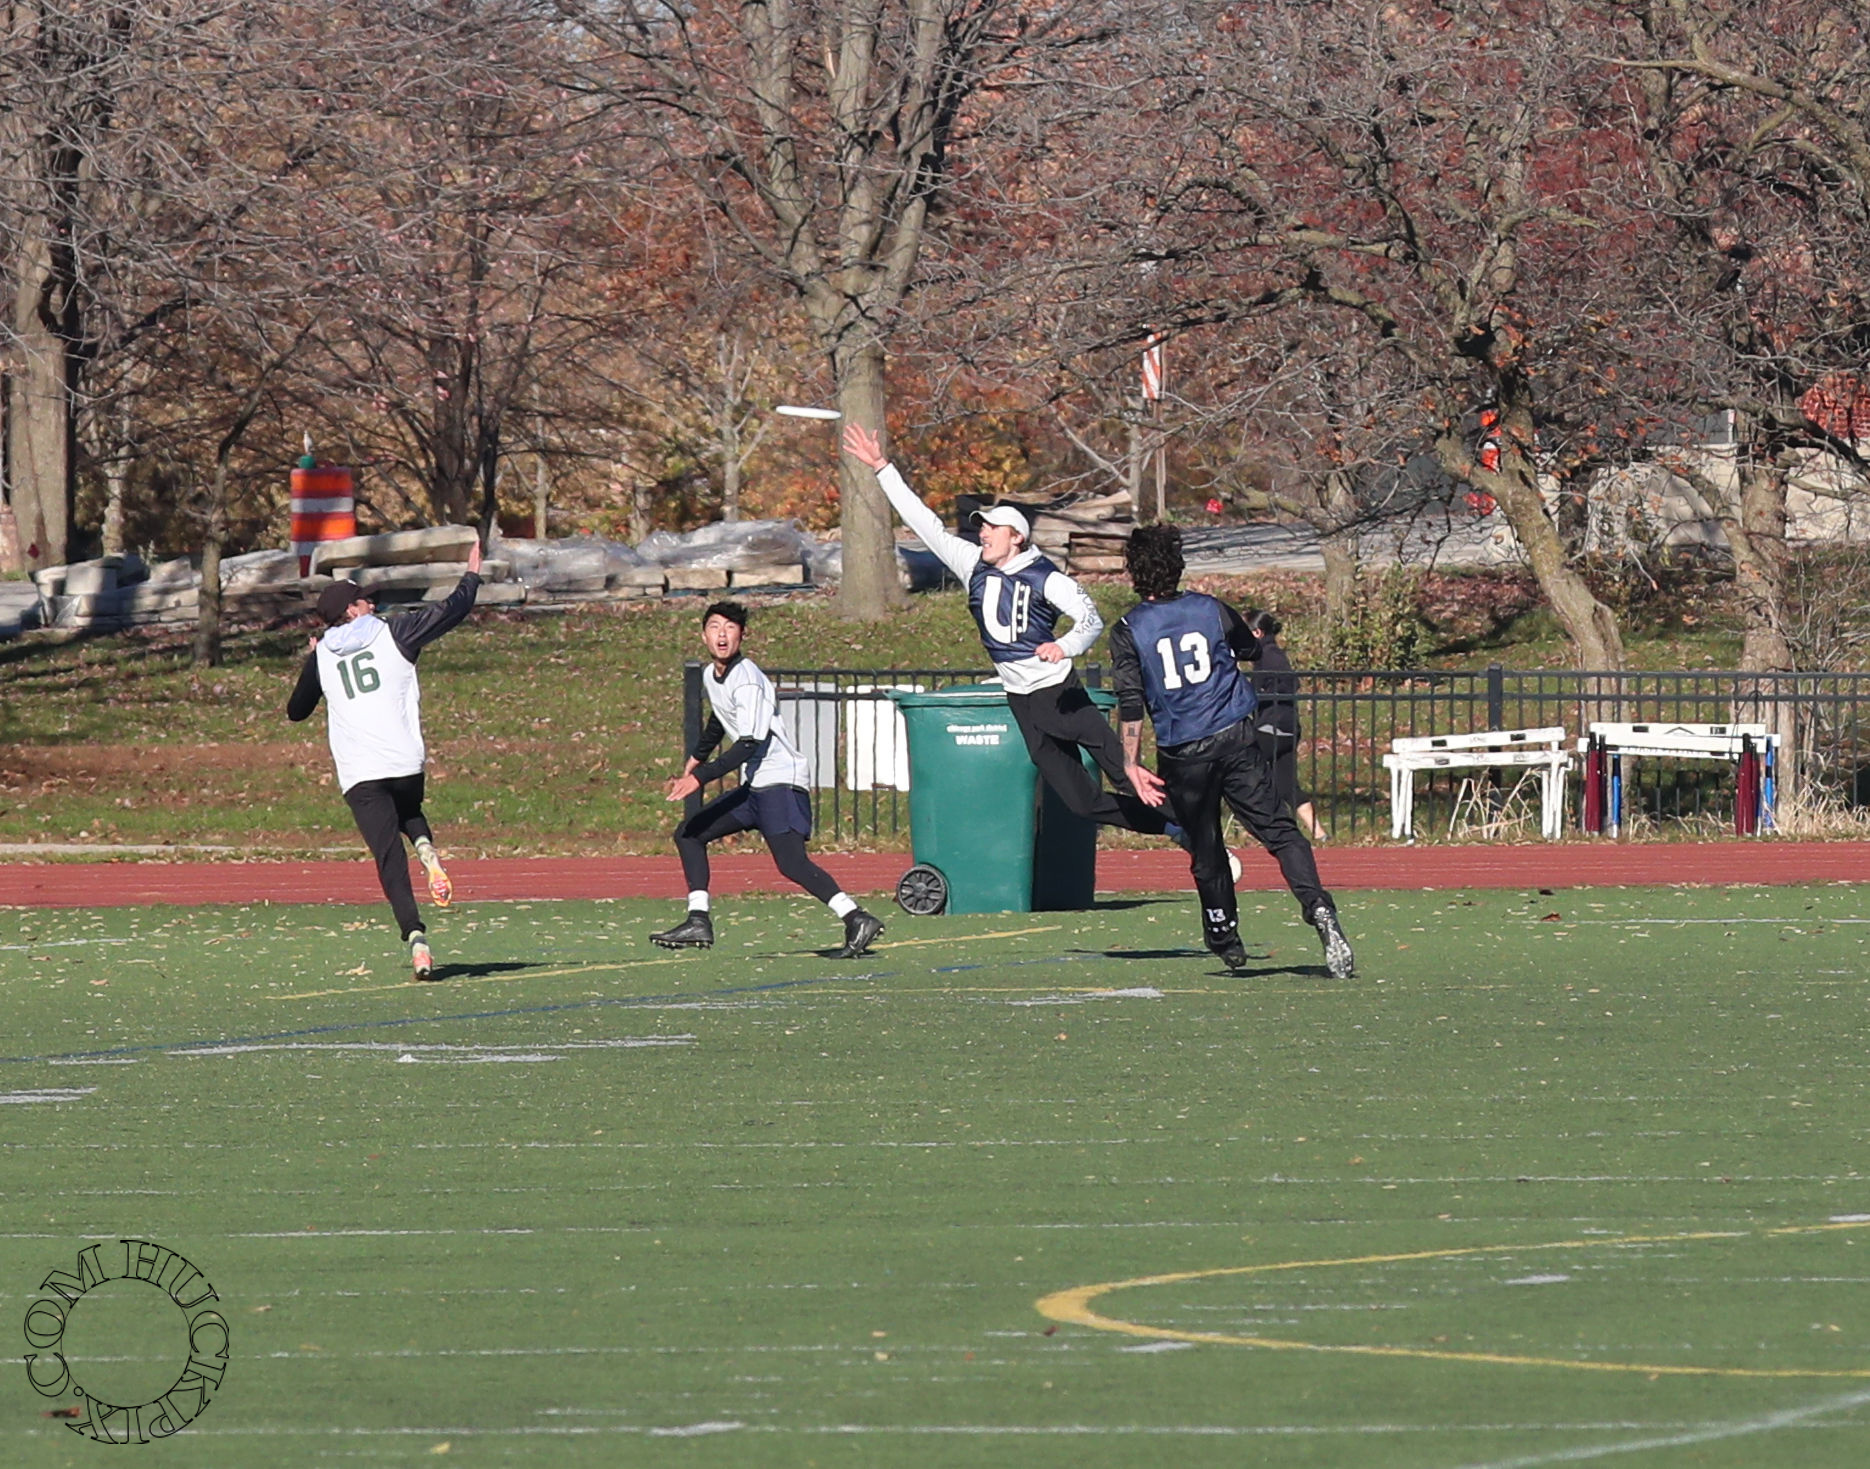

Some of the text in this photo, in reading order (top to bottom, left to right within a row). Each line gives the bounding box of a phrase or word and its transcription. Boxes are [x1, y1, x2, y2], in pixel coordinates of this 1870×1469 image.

[336, 650, 381, 700] 16
[1156, 631, 1212, 690] 13
[955, 734, 1000, 746] WASTE
[1205, 908, 1226, 923] 13
